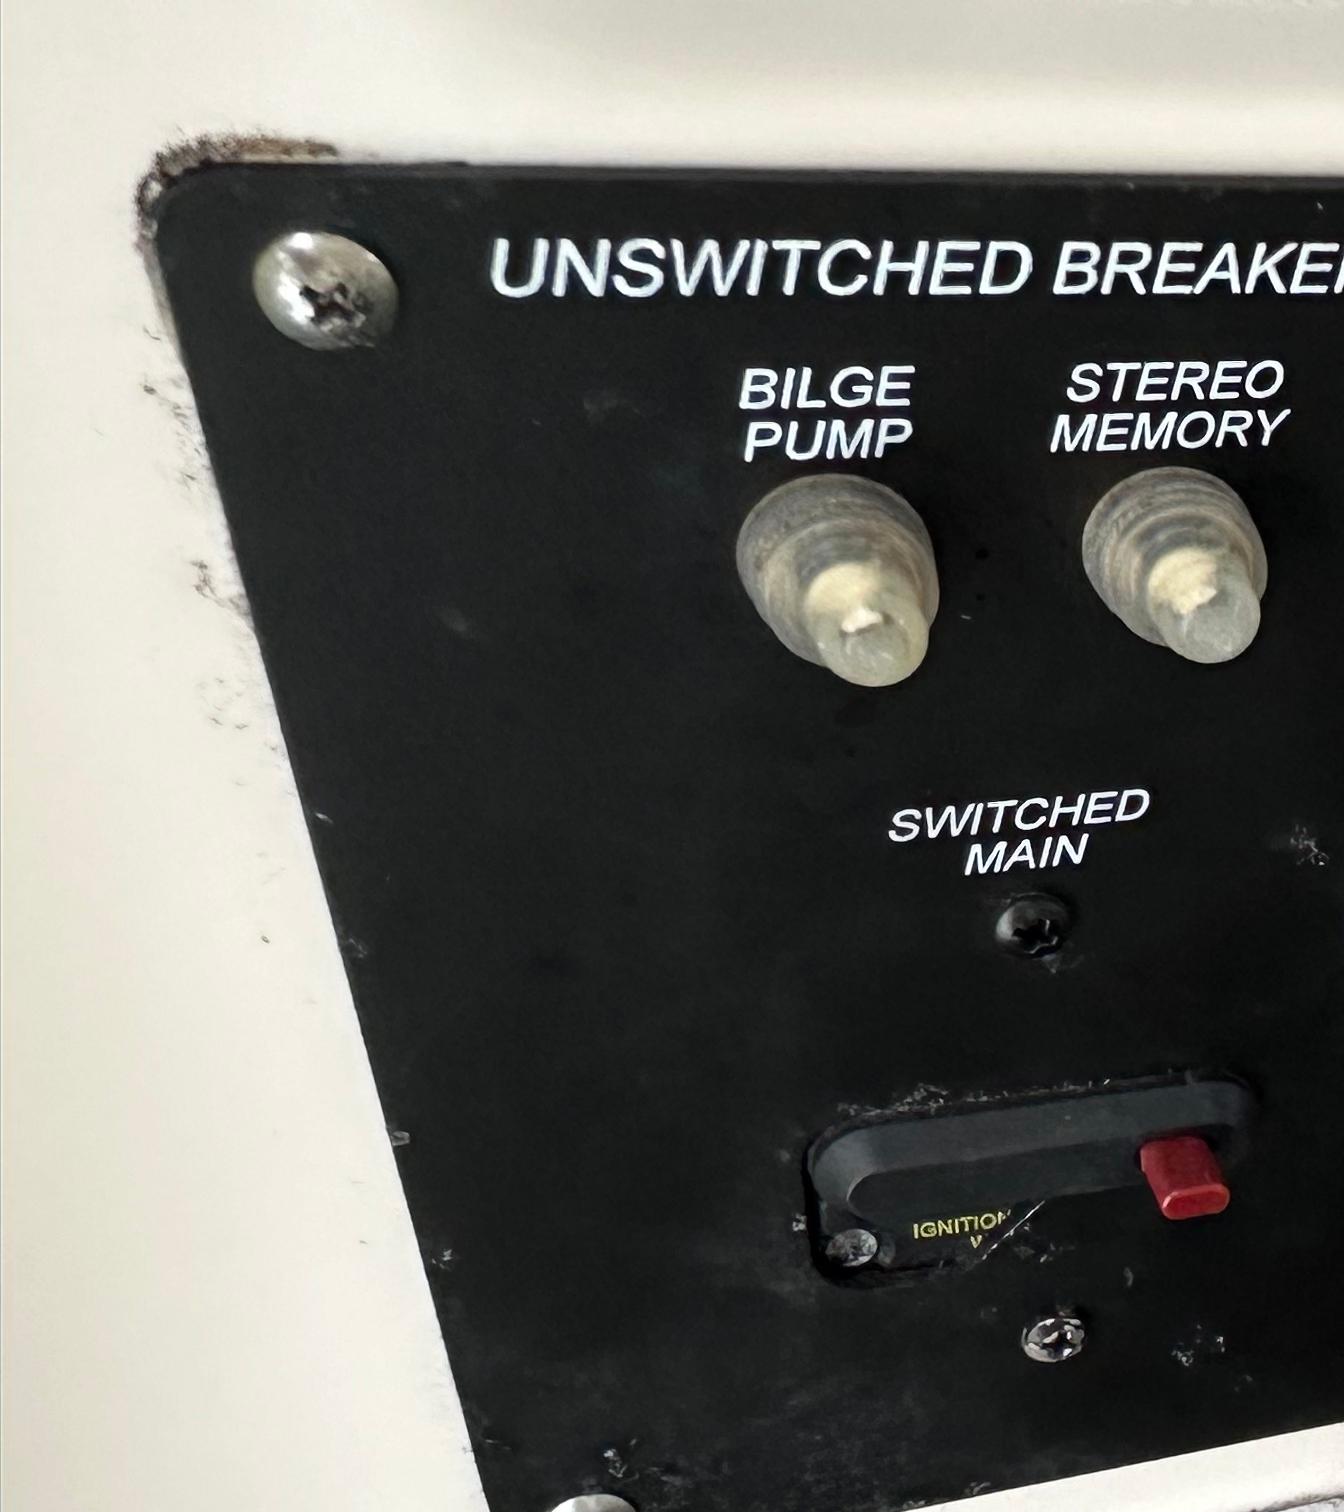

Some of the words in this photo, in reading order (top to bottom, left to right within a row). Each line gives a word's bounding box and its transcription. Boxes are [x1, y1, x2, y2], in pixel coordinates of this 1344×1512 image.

[490, 237, 1033, 299] UNSWITCHED
[739, 365, 916, 410] BILGE
[1066, 360, 1285, 402] STEREO
[743, 419, 913, 463] PUMP
[1050, 408, 1292, 453] MEMORY
[888, 788, 1150, 843] SWITCHED
[964, 834, 1090, 876] MAIN
[912, 1208, 1012, 1240] IGNITION
